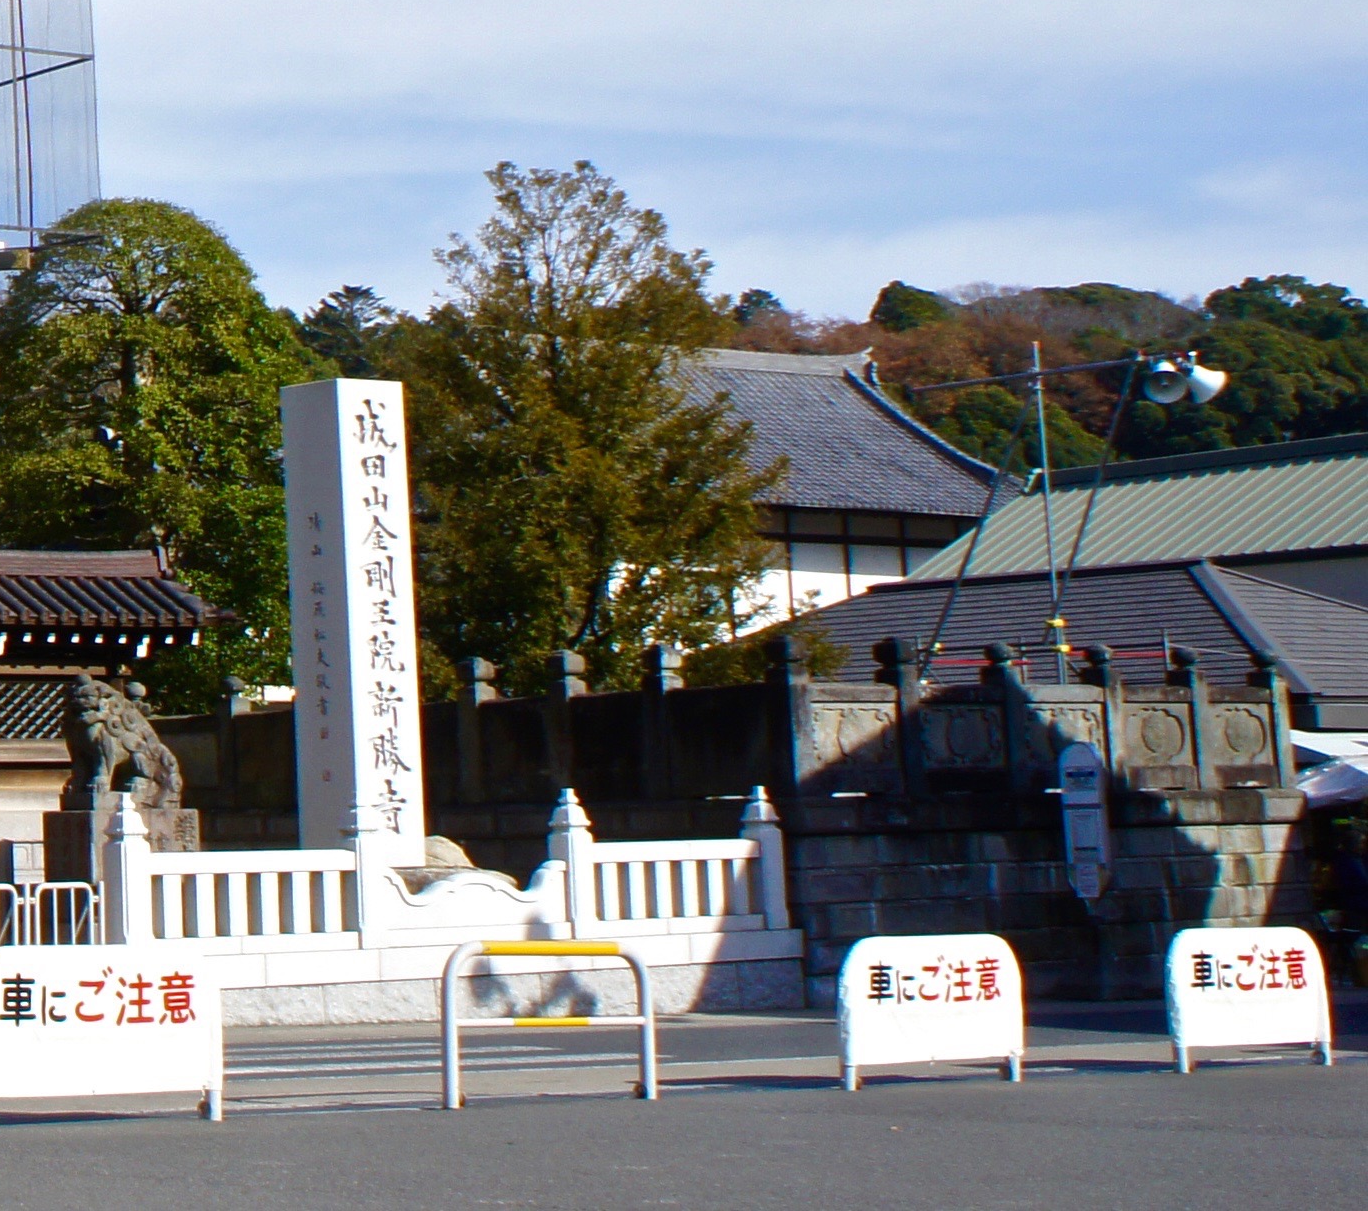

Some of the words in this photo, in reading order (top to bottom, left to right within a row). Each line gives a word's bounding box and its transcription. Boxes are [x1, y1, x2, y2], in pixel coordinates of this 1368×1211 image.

[353, 398, 412, 836] 成田山金剛王院新勝寺
[867, 954, 1002, 1006] 車にご注意
[1190, 944, 1308, 993] 車にご注意
